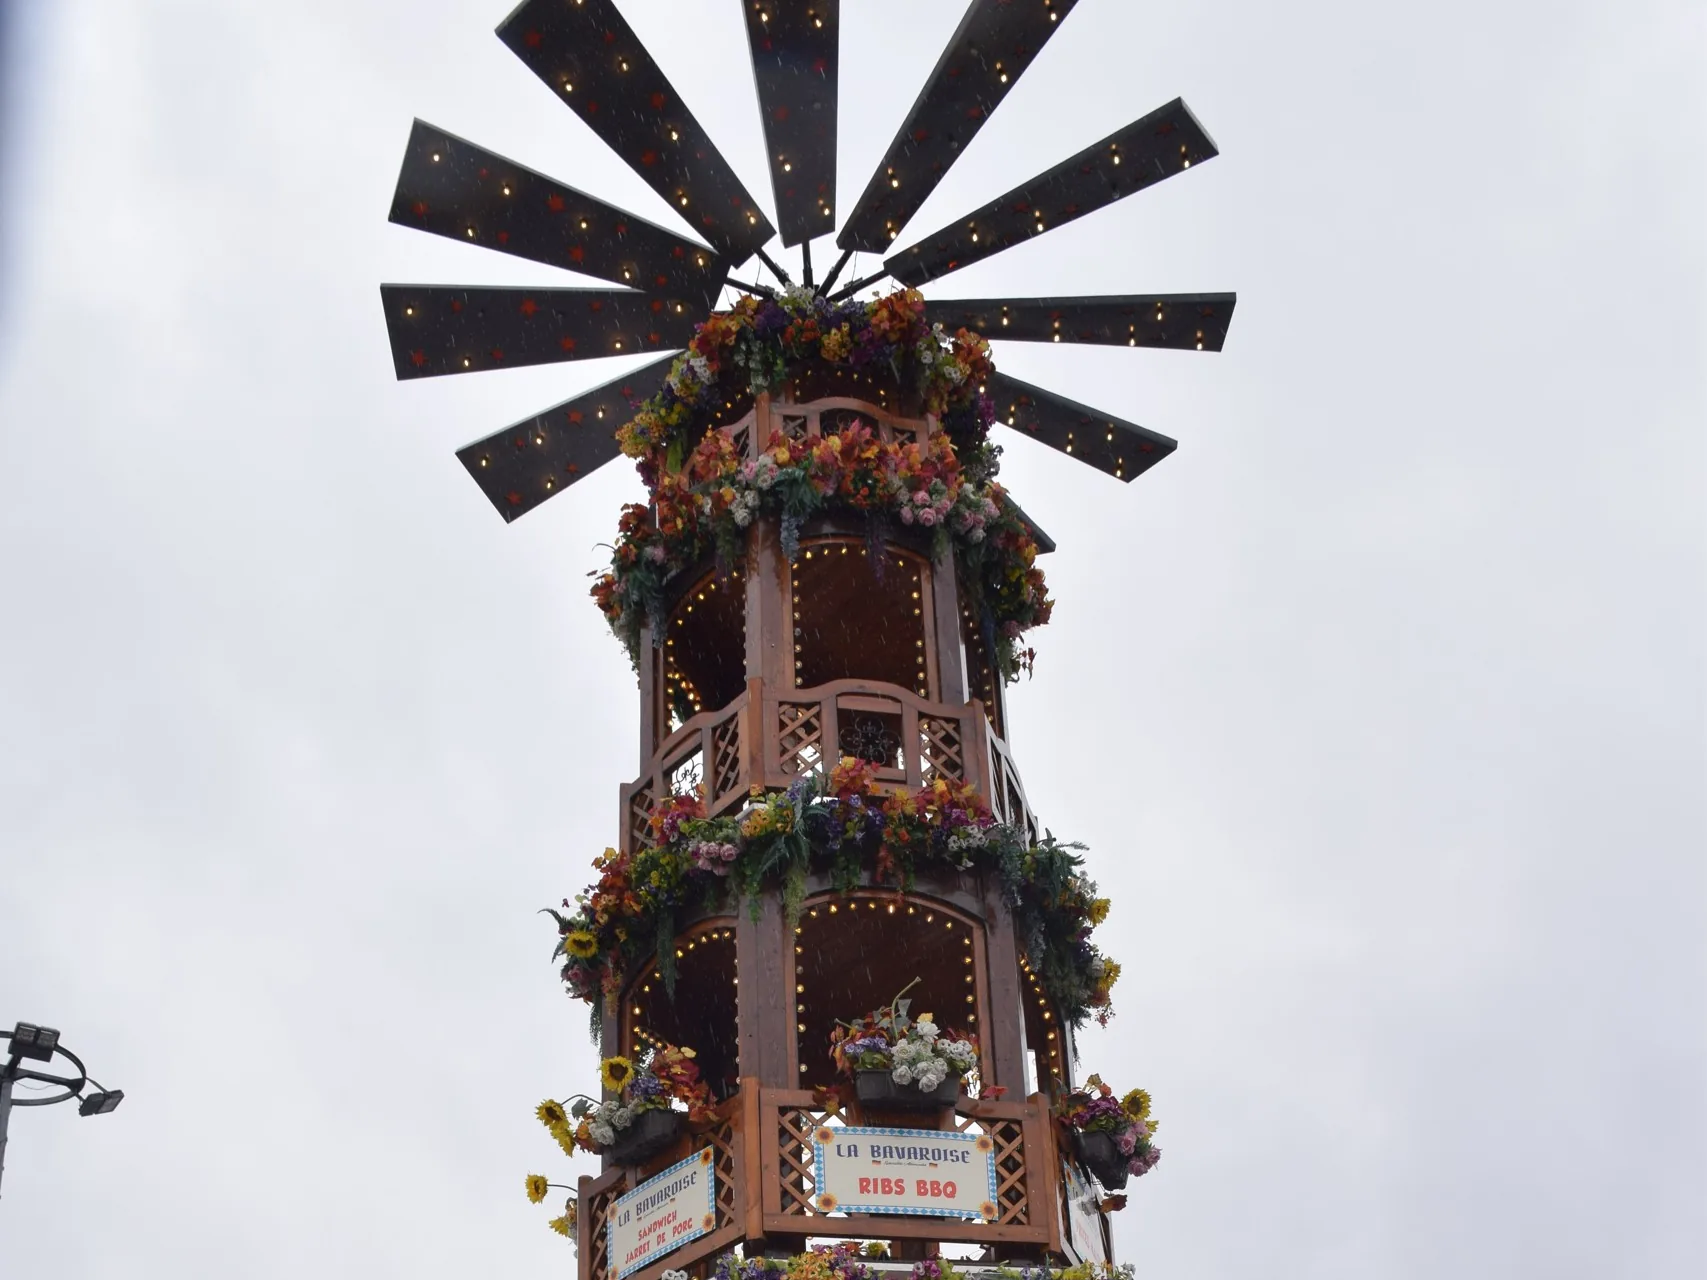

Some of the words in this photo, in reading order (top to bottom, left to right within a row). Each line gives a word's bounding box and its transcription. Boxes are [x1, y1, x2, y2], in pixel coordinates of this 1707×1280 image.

[837, 1144, 859, 1158] LA
[870, 1145, 971, 1164] BAVAROISE
[618, 1210, 630, 1227] LA
[636, 1171, 697, 1216] BAVAROISE
[859, 1178, 905, 1195] RIBS
[916, 1180, 957, 1199] BBQ
[625, 1241, 650, 1264] JARRET
[656, 1232, 665, 1246] DE
[672, 1217, 693, 1238] PORC
[638, 1210, 677, 1241] SANDWICH
